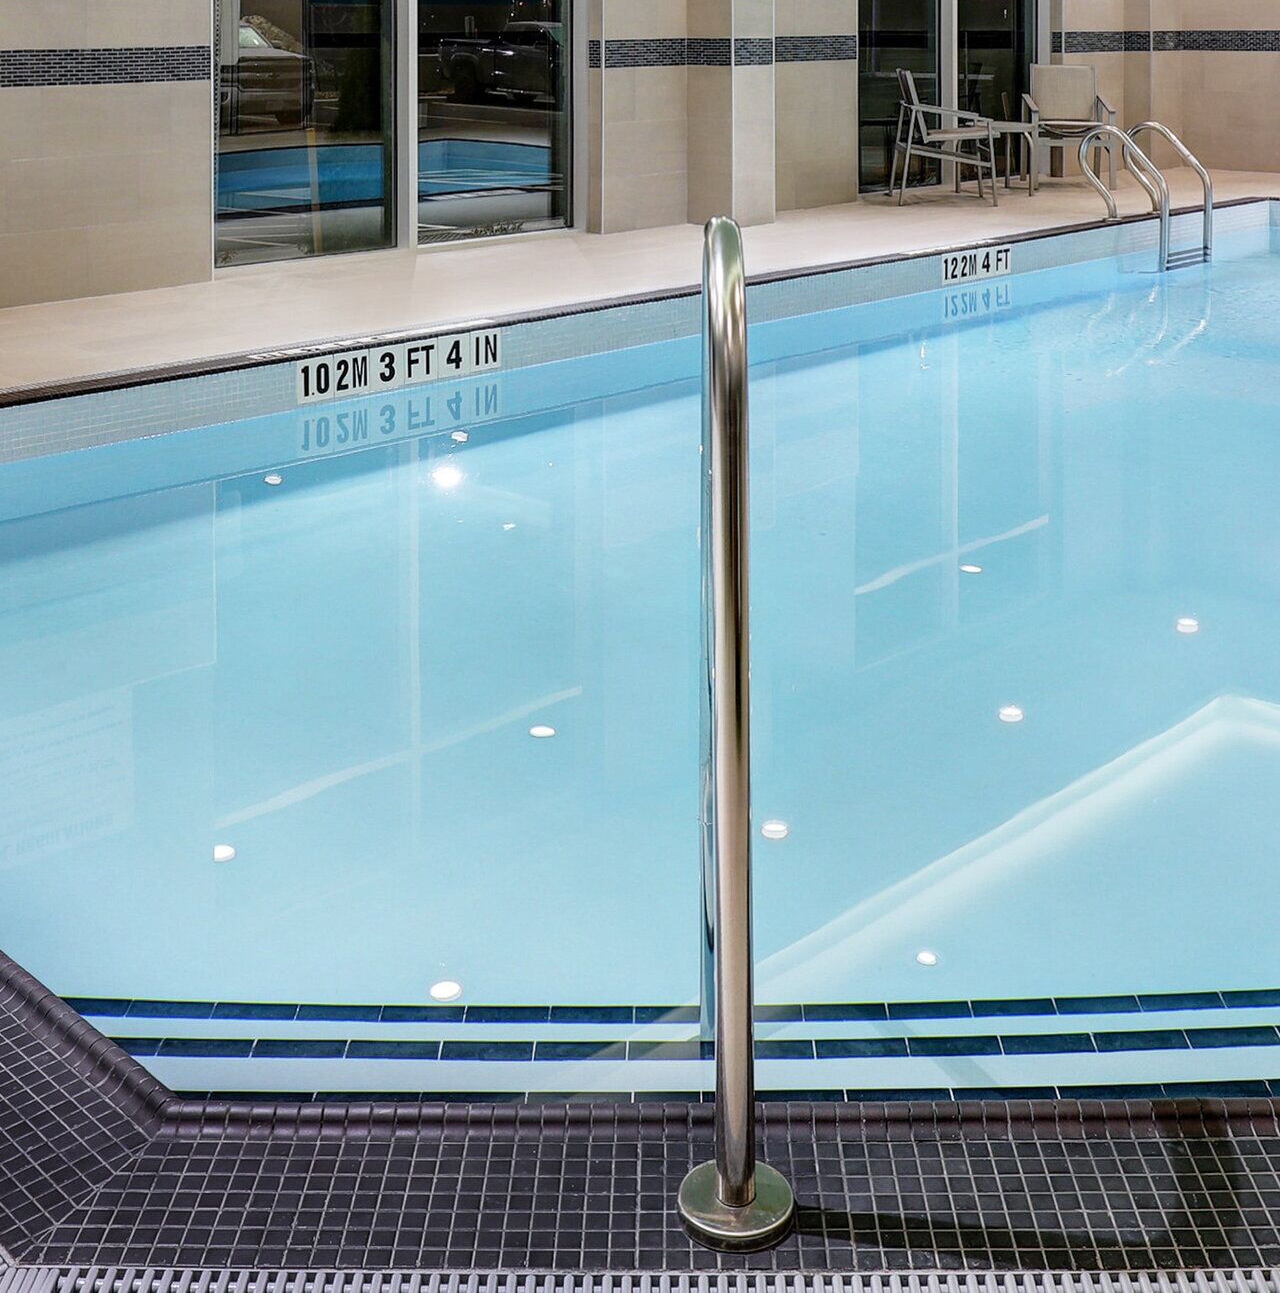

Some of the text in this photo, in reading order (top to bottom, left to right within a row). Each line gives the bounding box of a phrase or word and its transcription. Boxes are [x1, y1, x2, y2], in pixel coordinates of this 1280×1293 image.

[982, 252, 990, 272] 4
[996, 249, 1010, 271] FT
[301, 334, 497, 397] 1.02M 3 FT 4 IN
